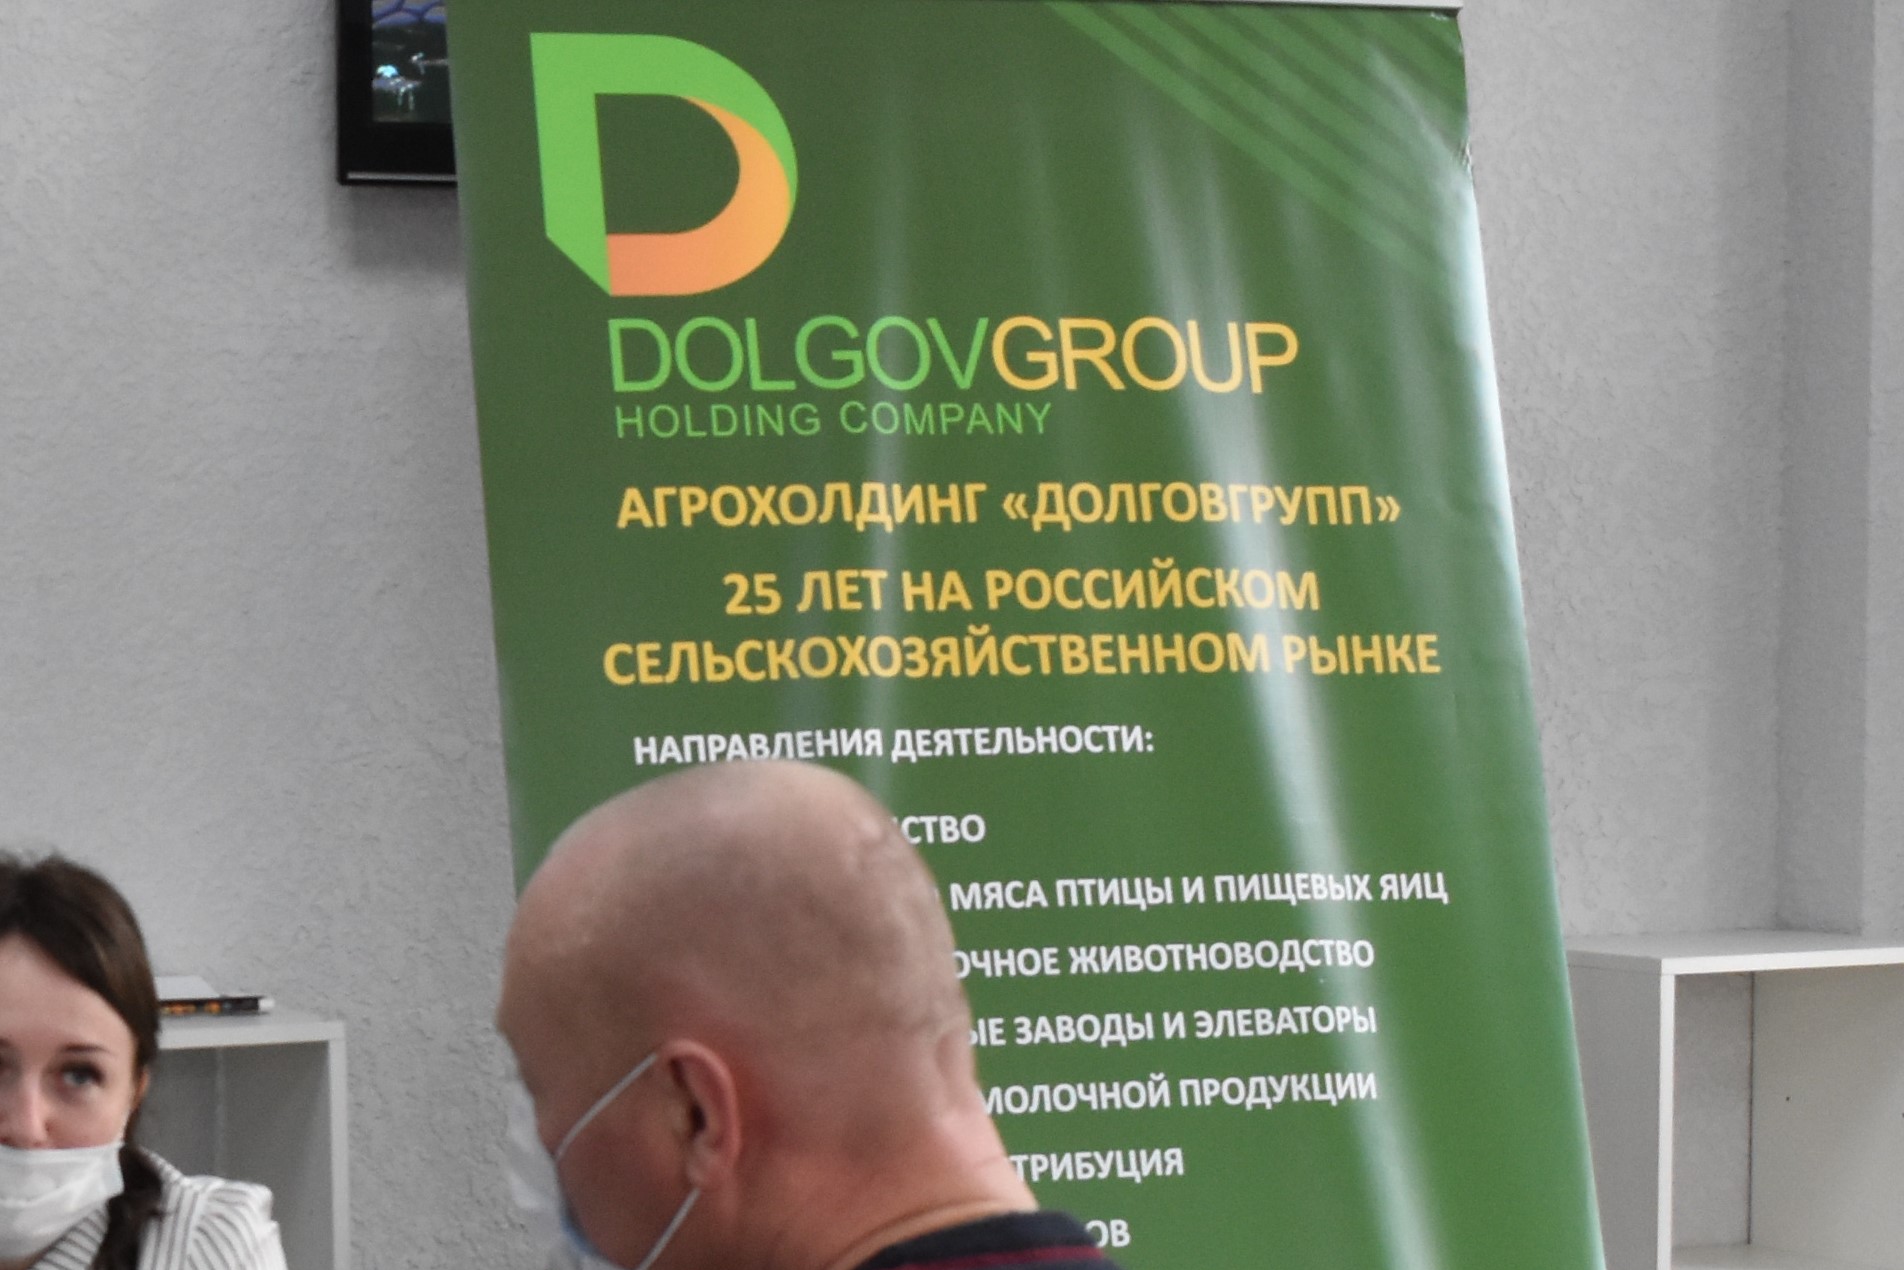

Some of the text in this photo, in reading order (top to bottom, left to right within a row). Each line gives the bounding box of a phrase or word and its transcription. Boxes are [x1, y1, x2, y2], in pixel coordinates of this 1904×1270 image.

[607, 314, 1299, 396] DOLGOVGROUP
[615, 399, 1052, 439] HOLDING COMPANY
[615, 480, 1401, 534] АГРОХОЛДИНГ «ДОЛГОВГРУПП»
[722, 557, 1320, 616] 25 ЛЕТ НА РОССИЙСКОМ
[603, 624, 1441, 686] СЕЛЬСКОХОЗЯЙСТВЕННОМ РЫНКЕ
[633, 724, 1154, 766] НАПРАВЛЕНИЯ ДЕЯТЕЛЬНОСТИ:
[895, 814, 986, 844] СТВО
[950, 871, 1449, 911] МЯСА ПТИЦЫ И ПИЩЕВЫХ ЯИЦ
[1068, 939, 1374, 976] ЖИВОТНОВОДСТВО
[1013, 1012, 1154, 1048] ЗАВОДЫ
[1163, 1011, 1186, 1041] И
[1195, 1006, 1377, 1040] ЭЛЕВАТОРЫ
[1179, 1071, 1377, 1112] ПРОДУКЦИИ
